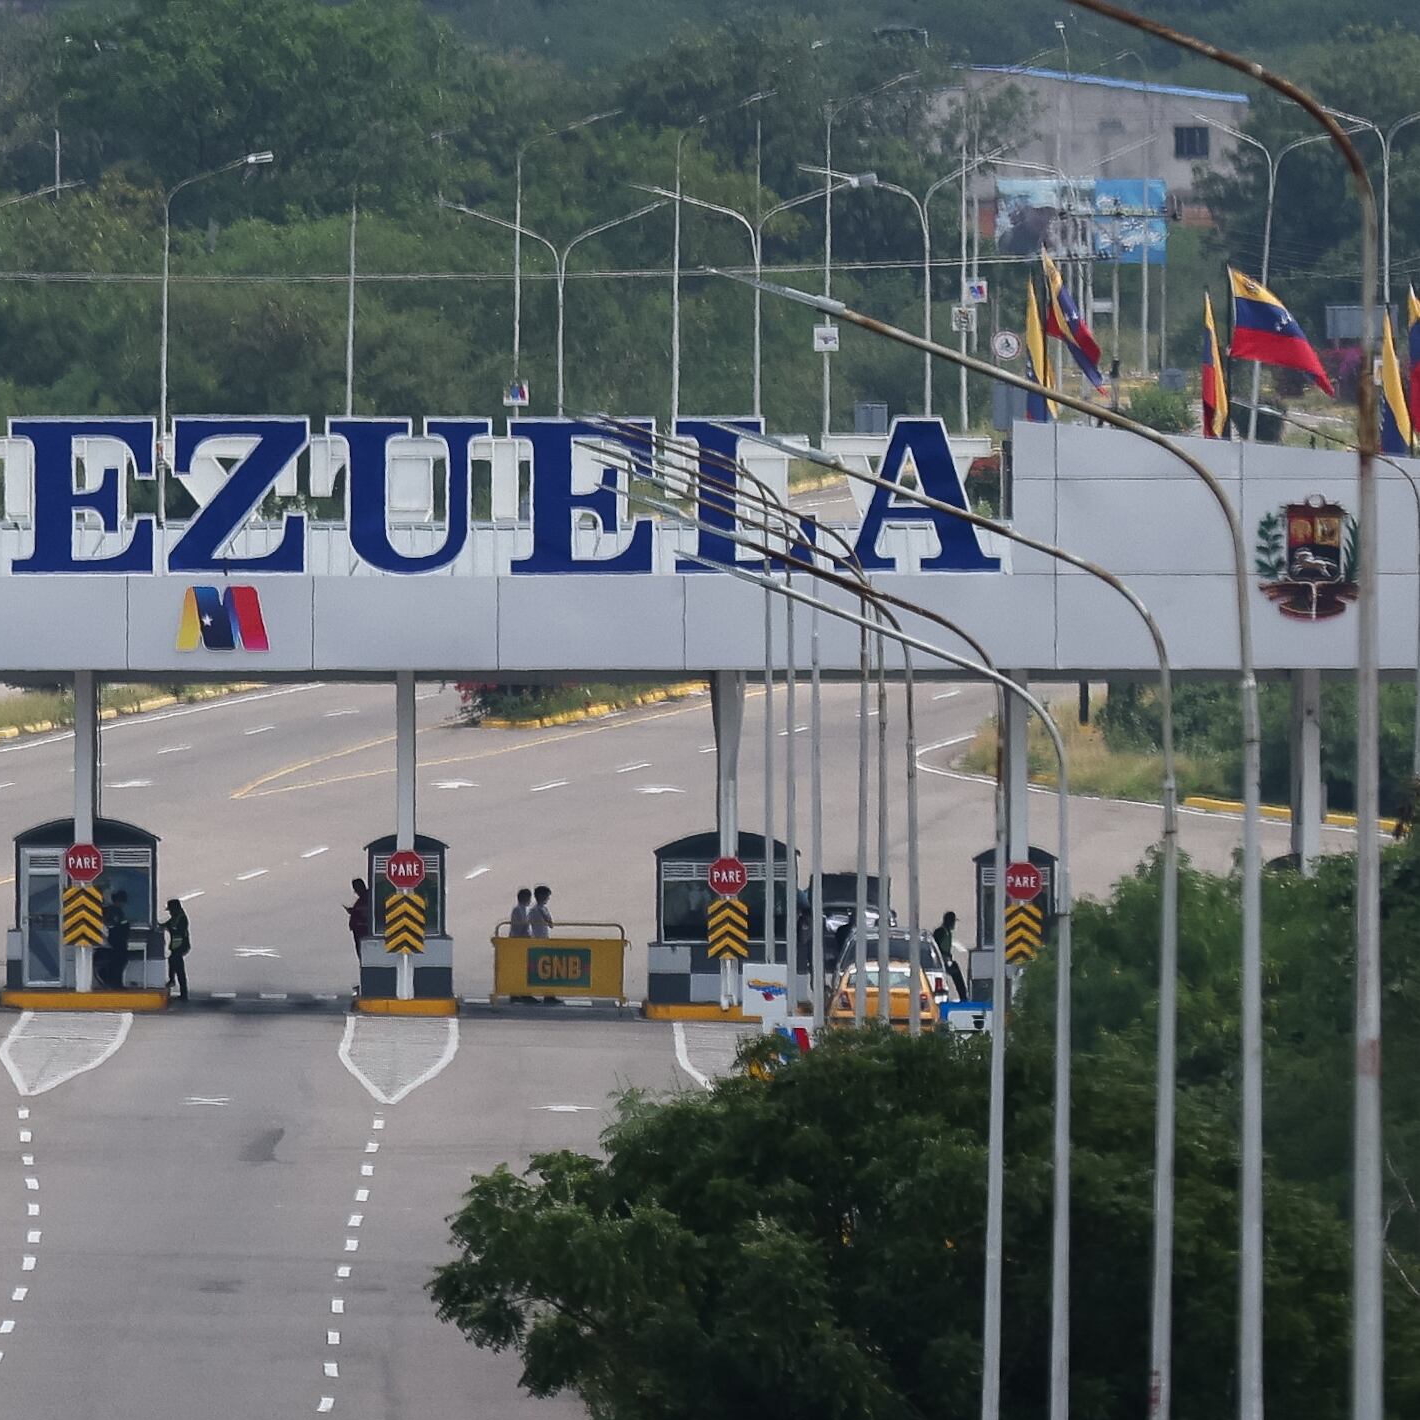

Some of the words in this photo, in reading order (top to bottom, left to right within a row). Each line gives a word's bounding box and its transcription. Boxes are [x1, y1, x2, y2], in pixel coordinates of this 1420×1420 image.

[69, 856, 98, 869] PARE
[391, 863, 419, 876] PARE
[713, 870, 742, 883] PARE
[1006, 875, 1036, 888] PARE
[537, 956, 581, 980] GNB
